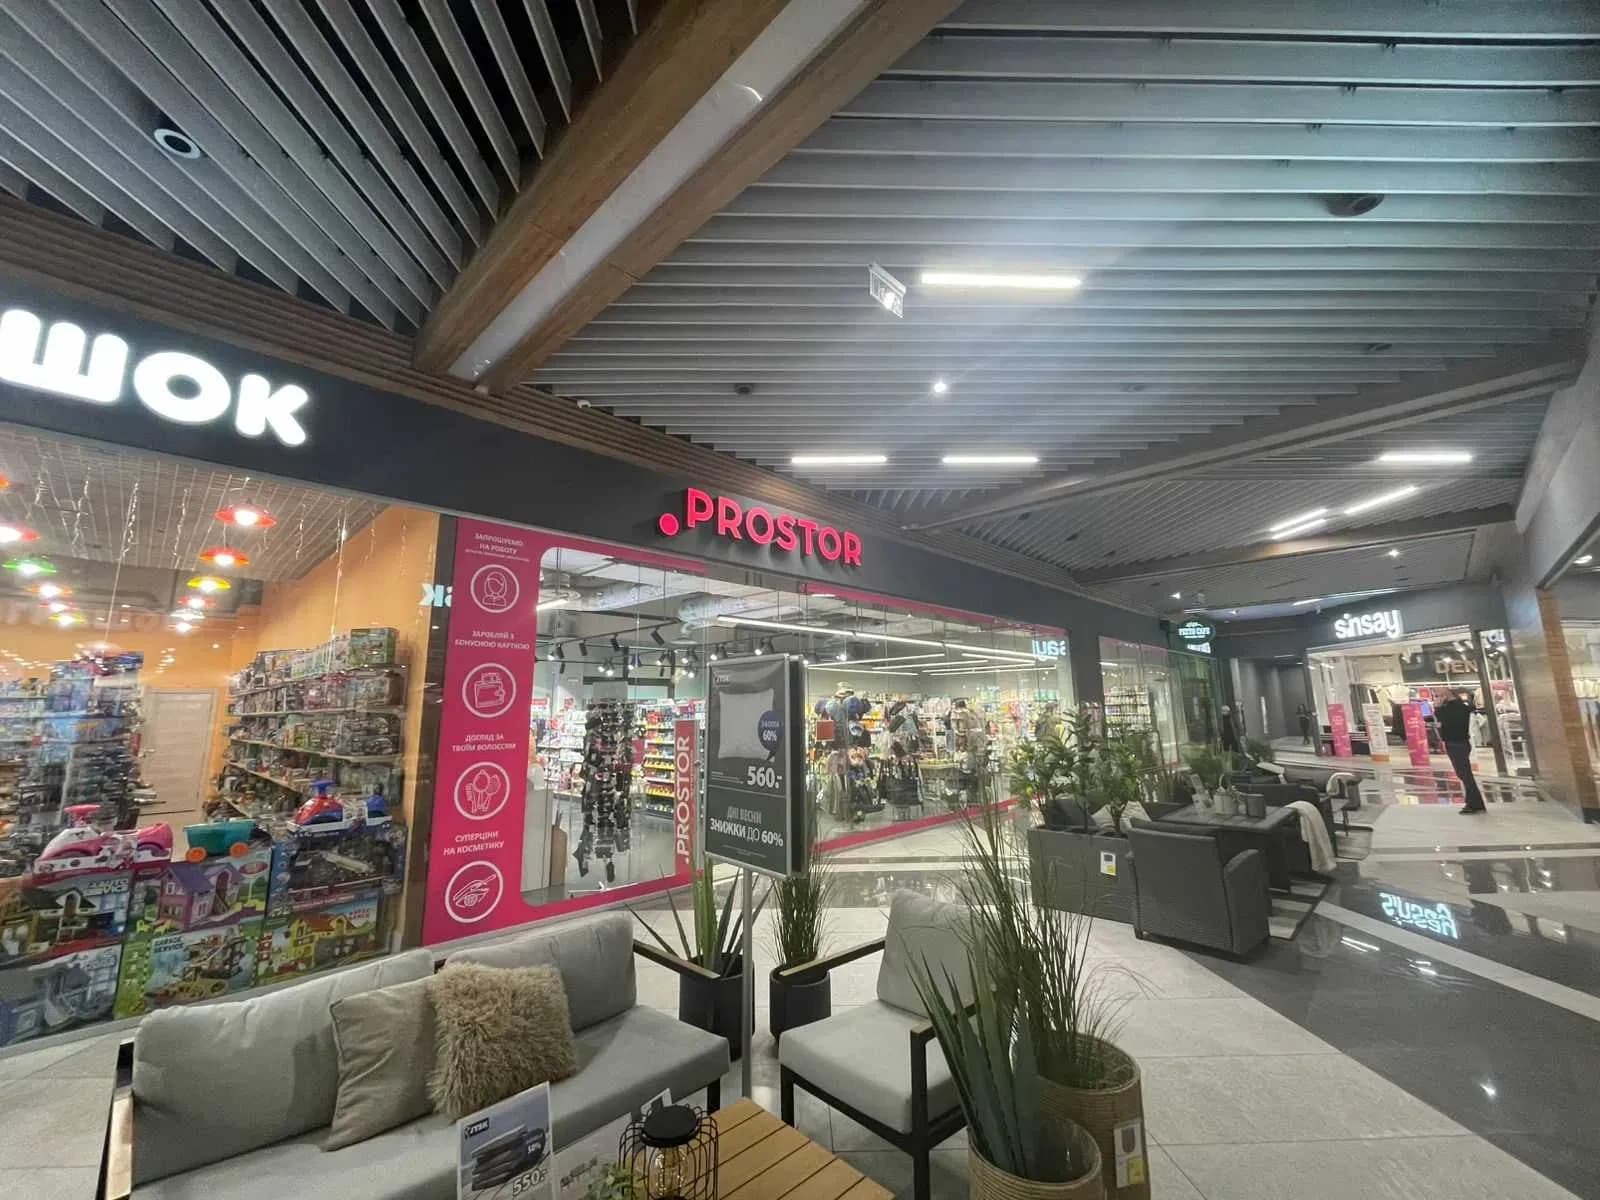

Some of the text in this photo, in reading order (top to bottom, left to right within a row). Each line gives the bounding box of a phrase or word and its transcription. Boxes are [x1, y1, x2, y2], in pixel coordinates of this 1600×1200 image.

[0, 308, 309, 446] ШОК
[1334, 608, 1400, 638] sinsay
[710, 818, 784, 847] ЗНИЖКИ ДО 60%
